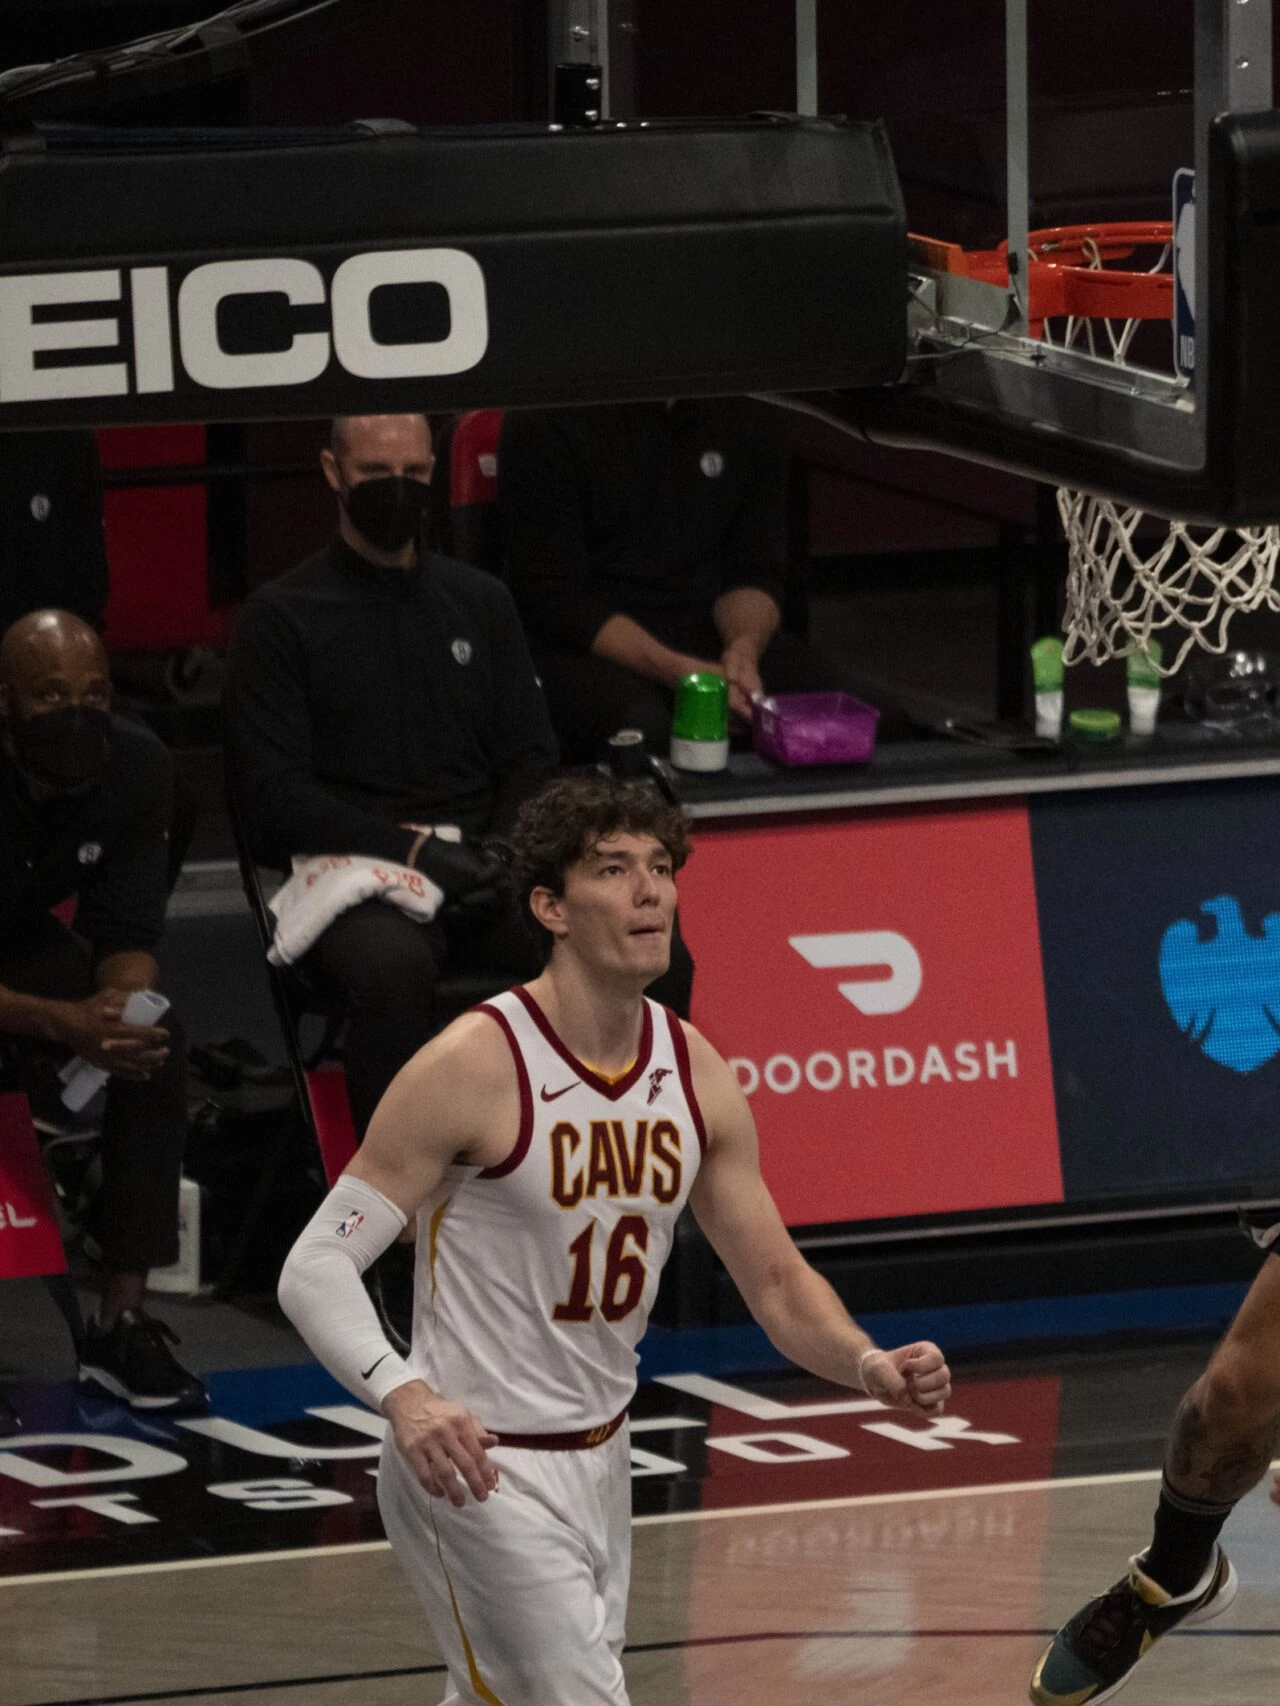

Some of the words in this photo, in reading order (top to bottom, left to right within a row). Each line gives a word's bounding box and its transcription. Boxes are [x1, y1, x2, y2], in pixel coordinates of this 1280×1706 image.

[0, 247, 489, 402] EICO
[727, 1039, 1018, 1096] DOORDASH
[551, 1120, 682, 1209] CAVS
[553, 1215, 649, 1323] 16
